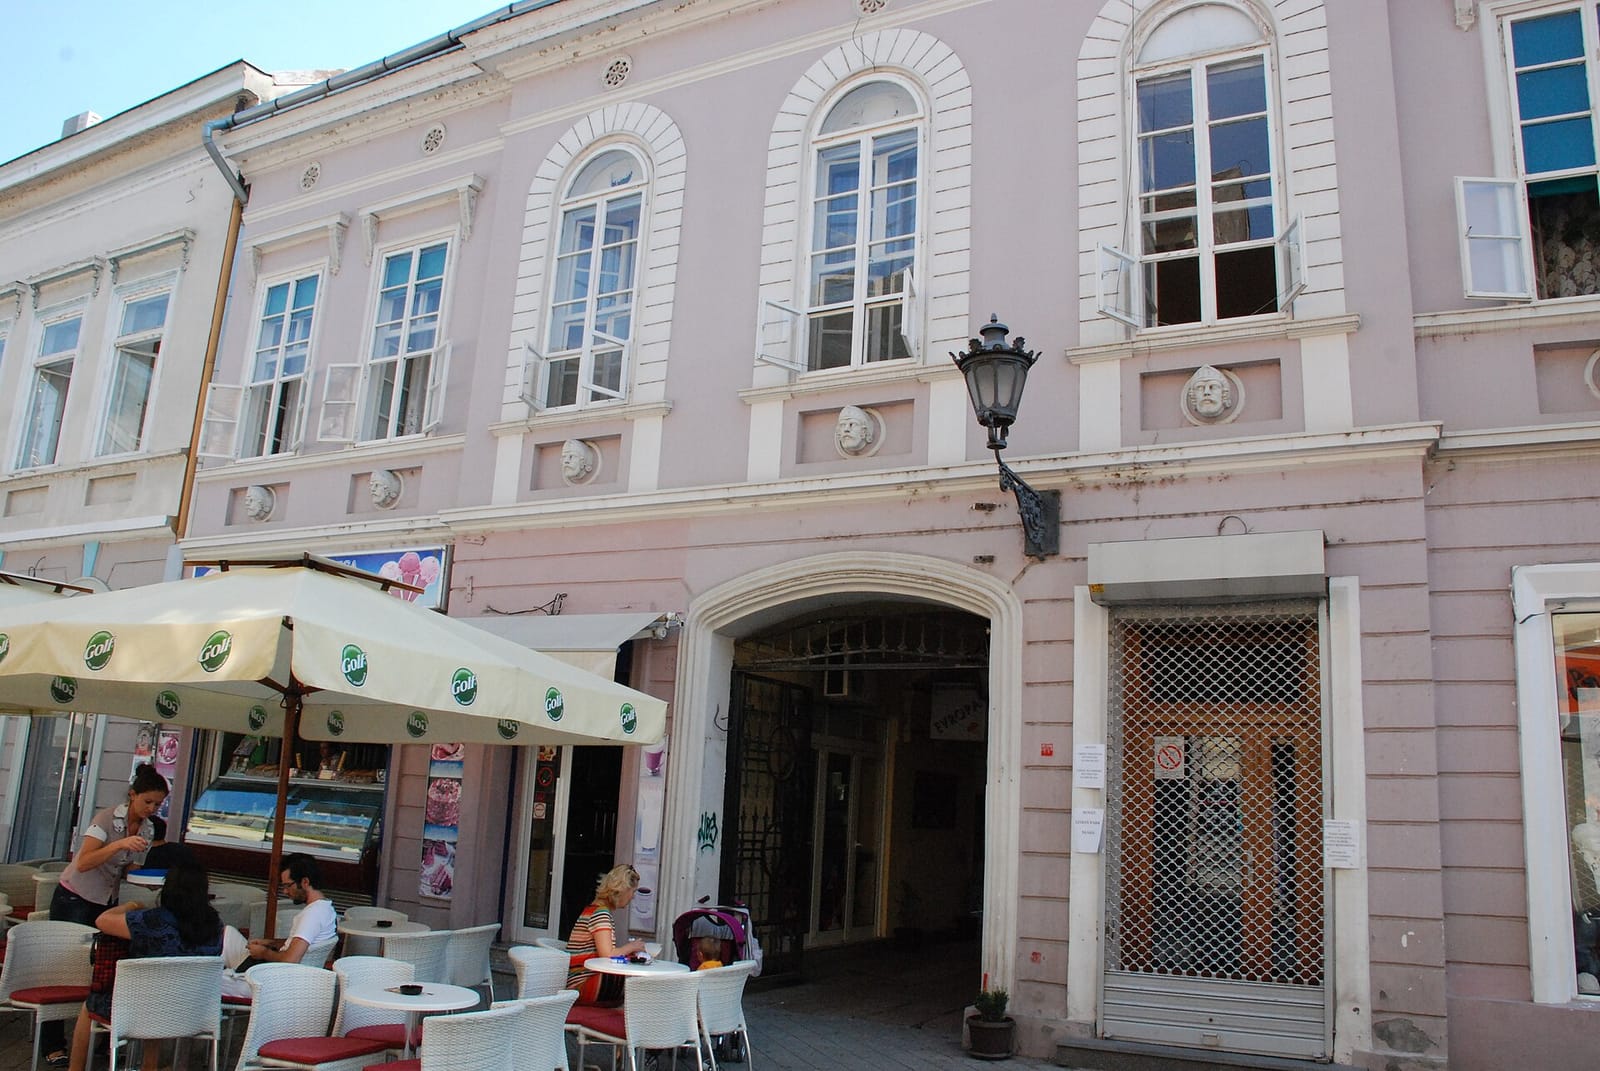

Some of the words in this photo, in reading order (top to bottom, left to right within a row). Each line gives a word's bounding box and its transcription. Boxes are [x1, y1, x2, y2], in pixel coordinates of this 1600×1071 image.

[84, 636, 116, 661] Golf
[199, 636, 233, 662] Golf
[342, 652, 367, 673] Golf
[452, 675, 477, 695] Golf
[545, 694, 562, 711] Golf
[621, 708, 636, 725] Golf
